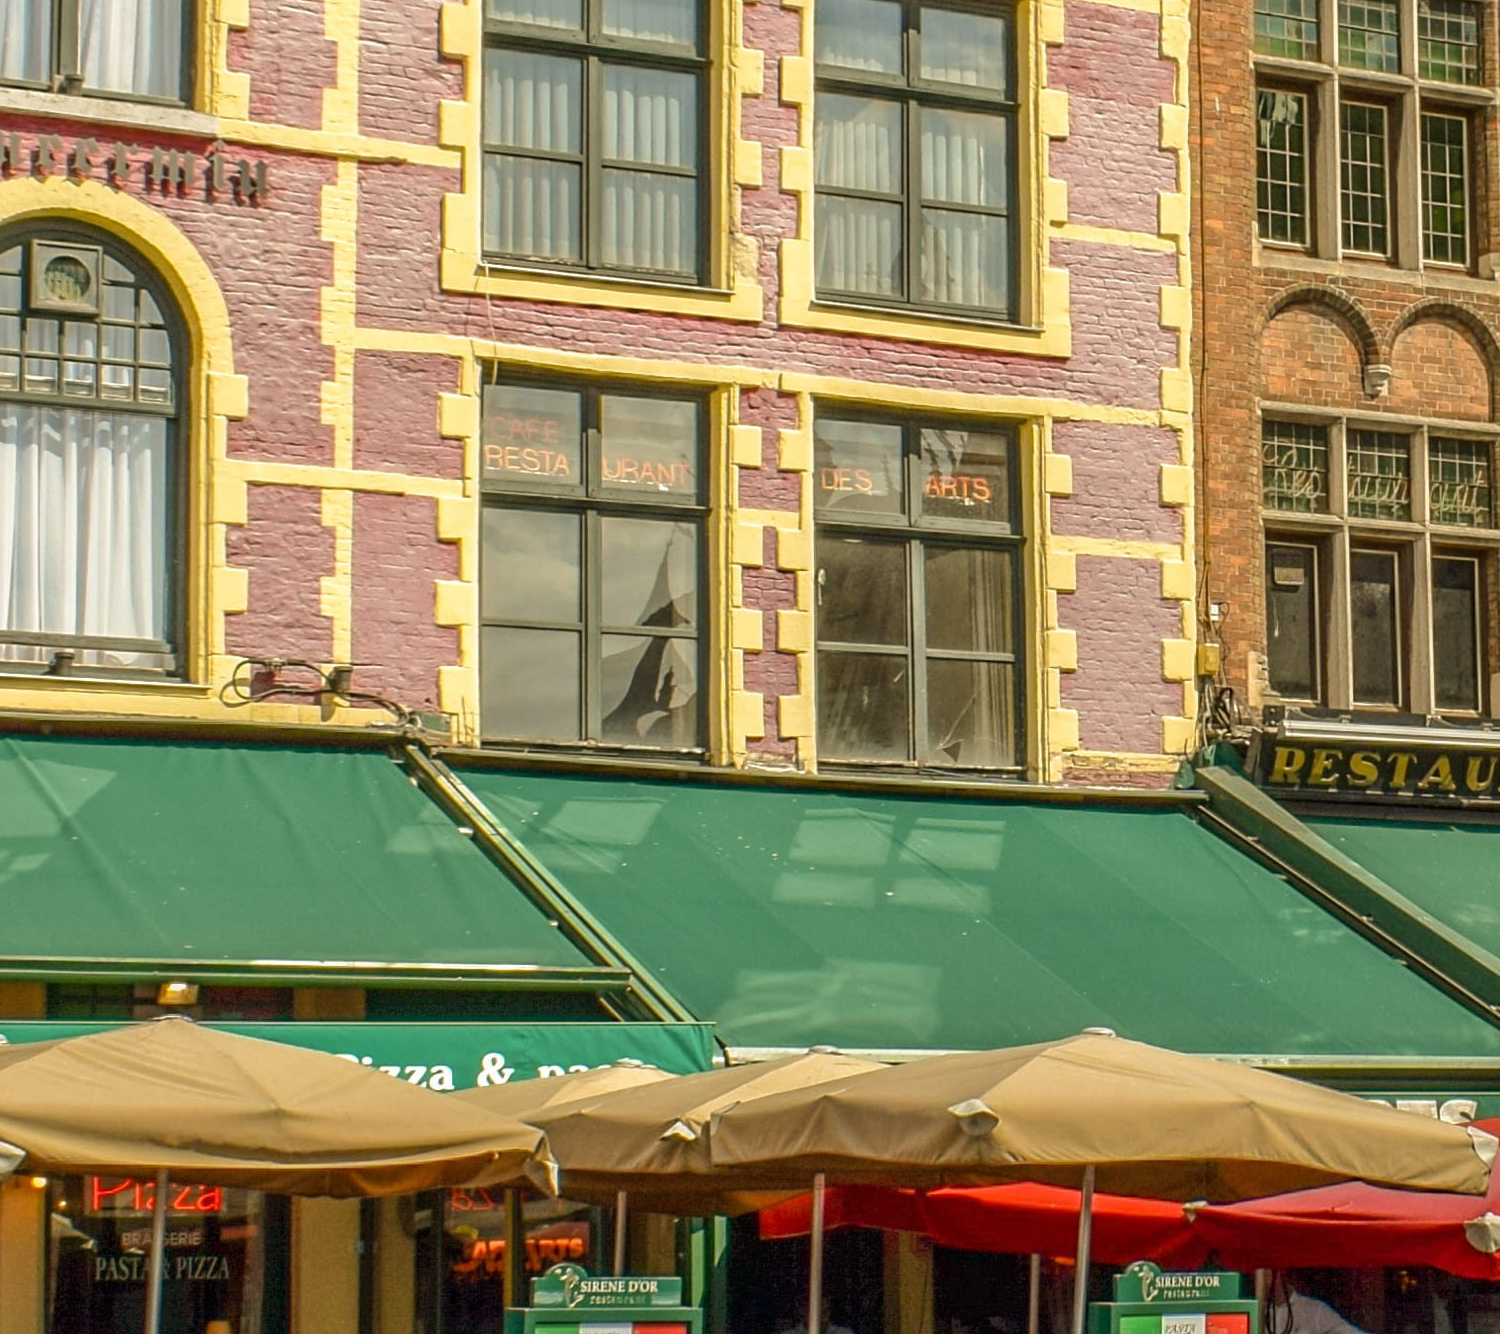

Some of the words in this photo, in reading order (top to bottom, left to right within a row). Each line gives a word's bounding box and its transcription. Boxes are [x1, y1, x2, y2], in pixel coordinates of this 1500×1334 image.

[492, 417, 557, 443] CAFE
[822, 467, 872, 493] DES
[925, 475, 991, 501] ARTS
[177, 1258, 230, 1280] PIZZA
[581, 1281, 625, 1293] SIRENE
[628, 1280, 658, 1292] D'OR
[1155, 1276, 1193, 1287] SIRENE
[1195, 1276, 1220, 1287] D'OR
